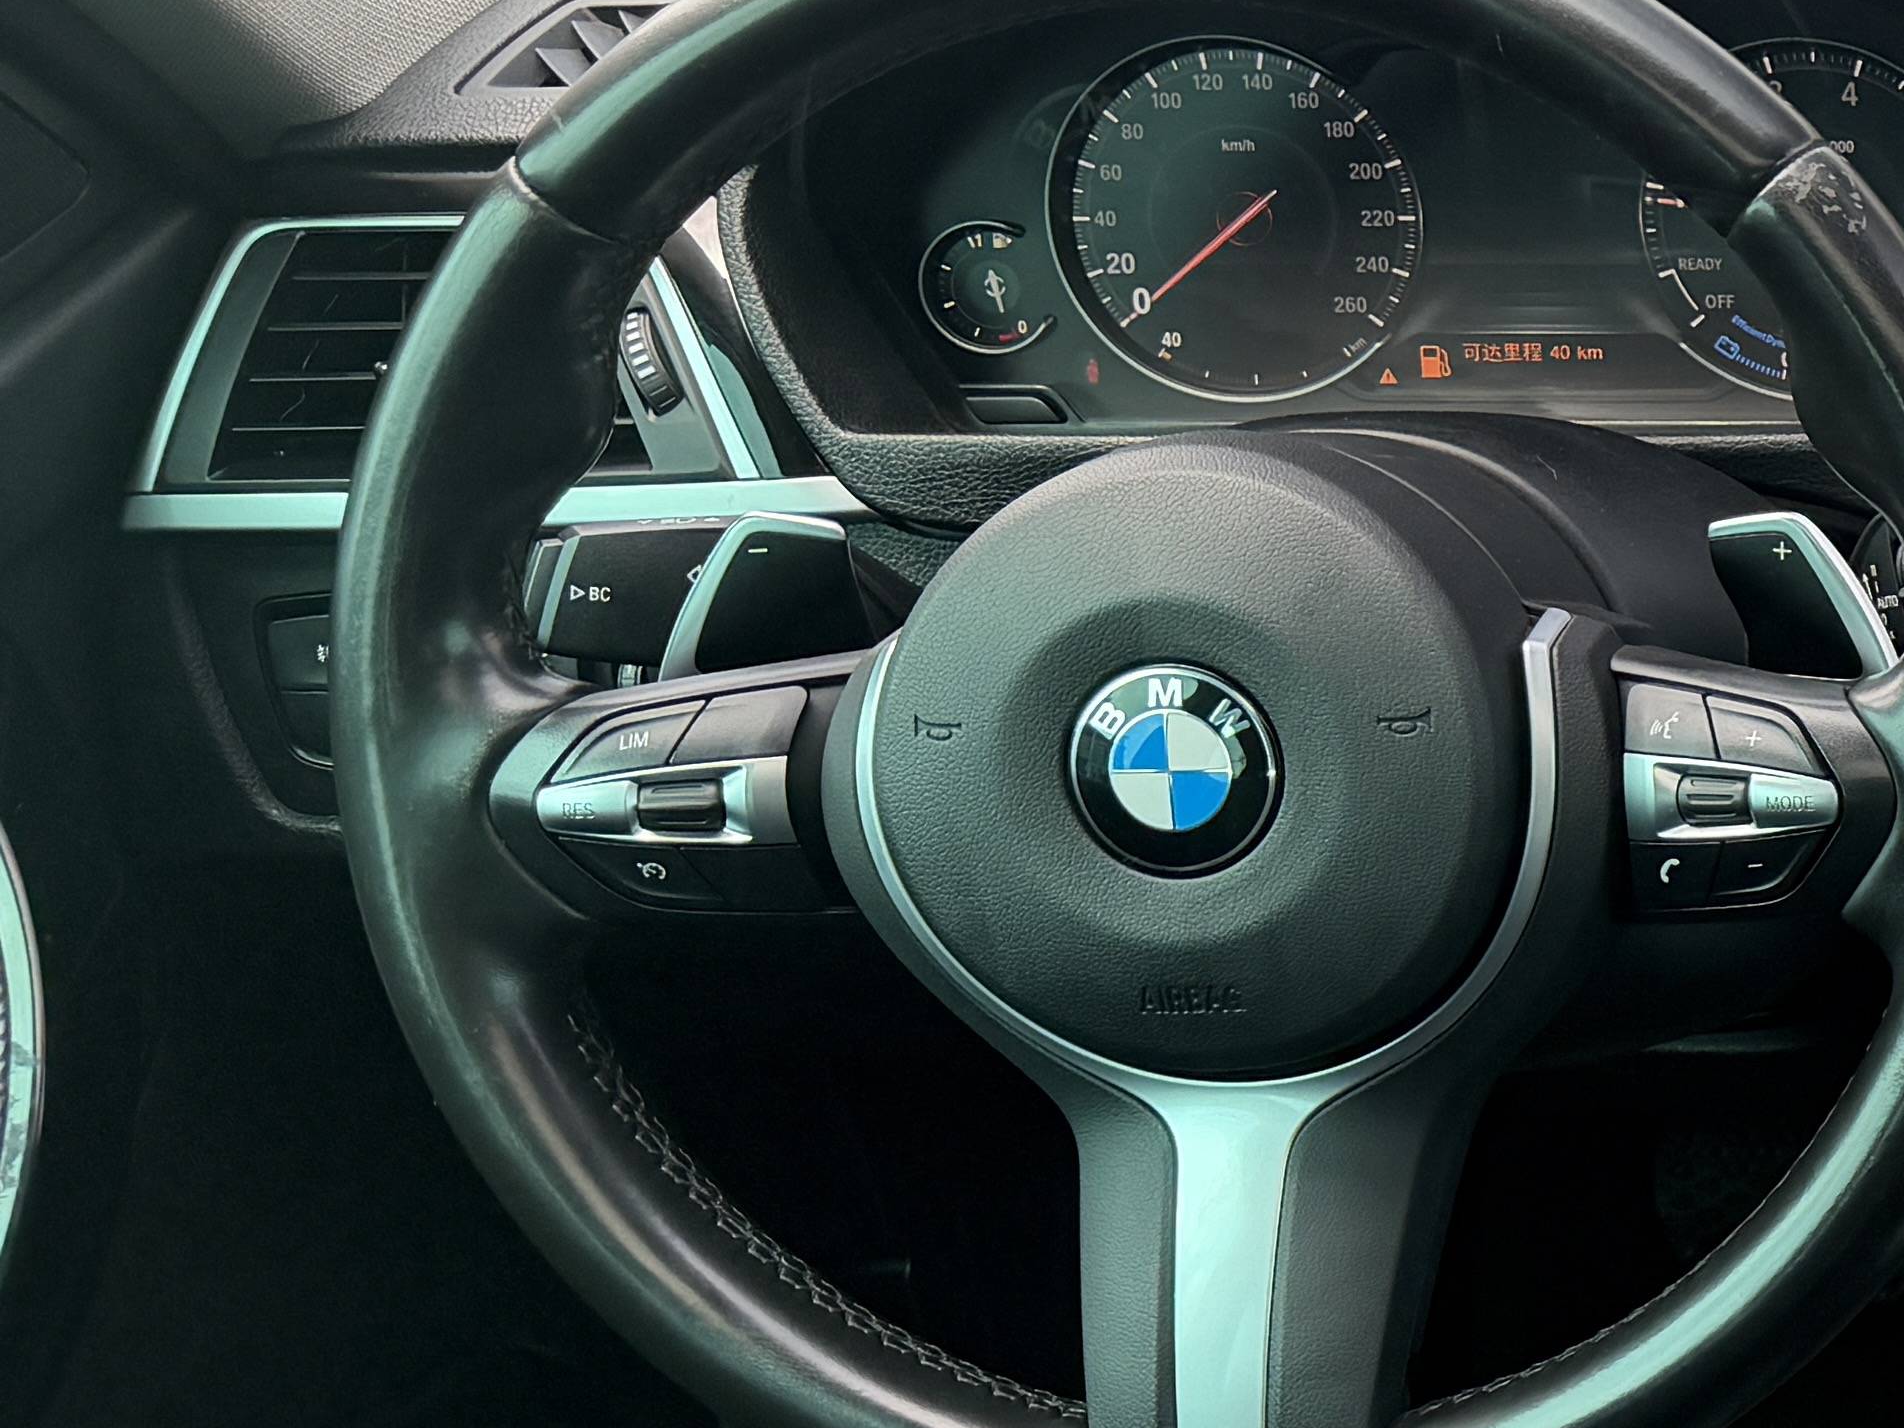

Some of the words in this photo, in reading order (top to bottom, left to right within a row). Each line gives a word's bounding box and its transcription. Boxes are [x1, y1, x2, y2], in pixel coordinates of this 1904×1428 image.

[1193, 74, 1223, 91] 120
[1242, 74, 1273, 90] 140
[1151, 92, 1182, 109] 100
[1289, 92, 1319, 109] 160
[1841, 82, 1858, 107] 4
[1121, 123, 1144, 140] 80
[1324, 122, 1354, 138] 180
[1221, 139, 1255, 152] km/h
[1100, 164, 1122, 181] 60
[1350, 163, 1382, 180] 200
[1095, 210, 1117, 227] 40
[1361, 210, 1394, 227] 220
[1106, 253, 1135, 274] 20
[1356, 256, 1389, 273] 240
[1678, 257, 1722, 271] READY
[1133, 287, 1152, 314] 0
[1334, 297, 1367, 313] 260
[1705, 294, 1736, 309] OFF
[1162, 332, 1182, 348] 40
[1462, 342, 1544, 363] 可达里程
[1550, 344, 1571, 360] 40
[1577, 345, 1604, 360] km
[589, 586, 612, 602] BC
[1089, 677, 1251, 741] BMW
[619, 731, 649, 750] LIM
[562, 802, 596, 819] RES
[1766, 795, 1816, 812] MODE
